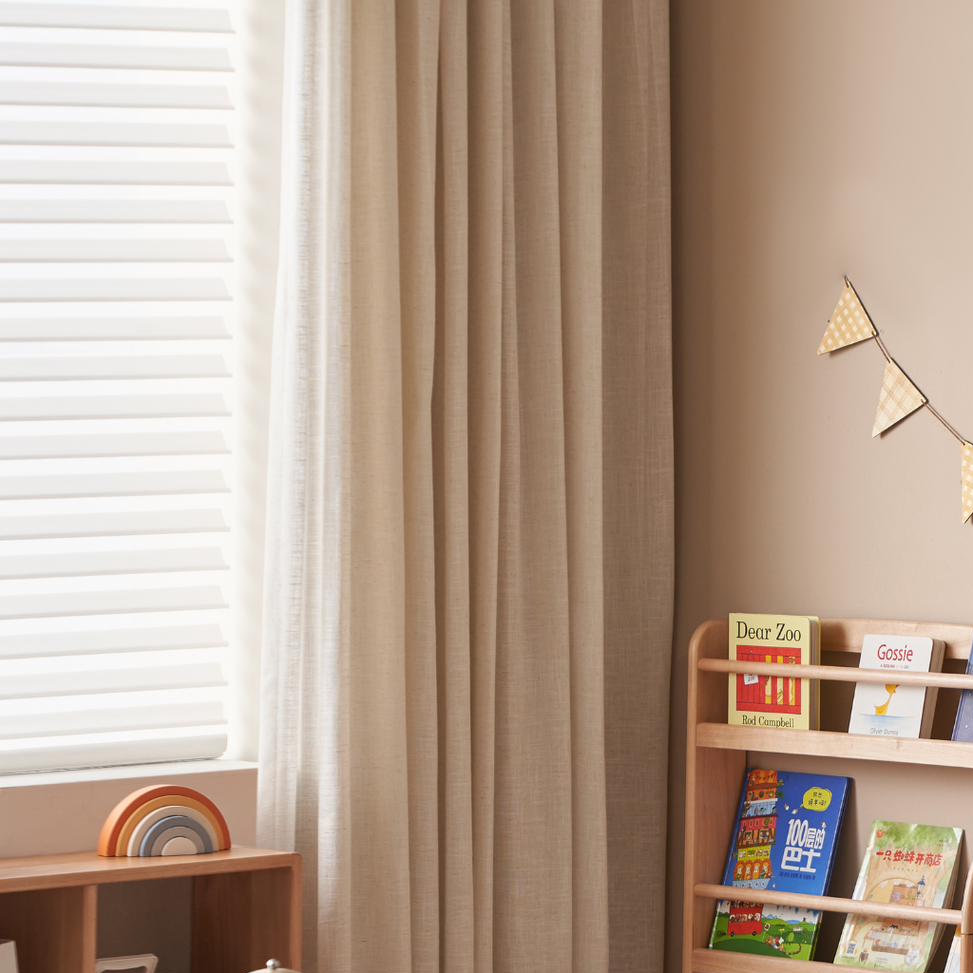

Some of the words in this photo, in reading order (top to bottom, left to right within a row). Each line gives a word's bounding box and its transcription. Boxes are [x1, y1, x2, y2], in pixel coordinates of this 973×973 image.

[736, 621, 771, 640] Dear
[776, 623, 801, 641] Zoo
[877, 644, 913, 662] Gossie
[742, 715, 756, 725] Rod
[759, 716, 794, 728] Campbell
[786, 819, 825, 849] 100层的
[781, 846, 821, 873] 巴士
[876, 850, 942, 866] 一只蜘蛛开商店
